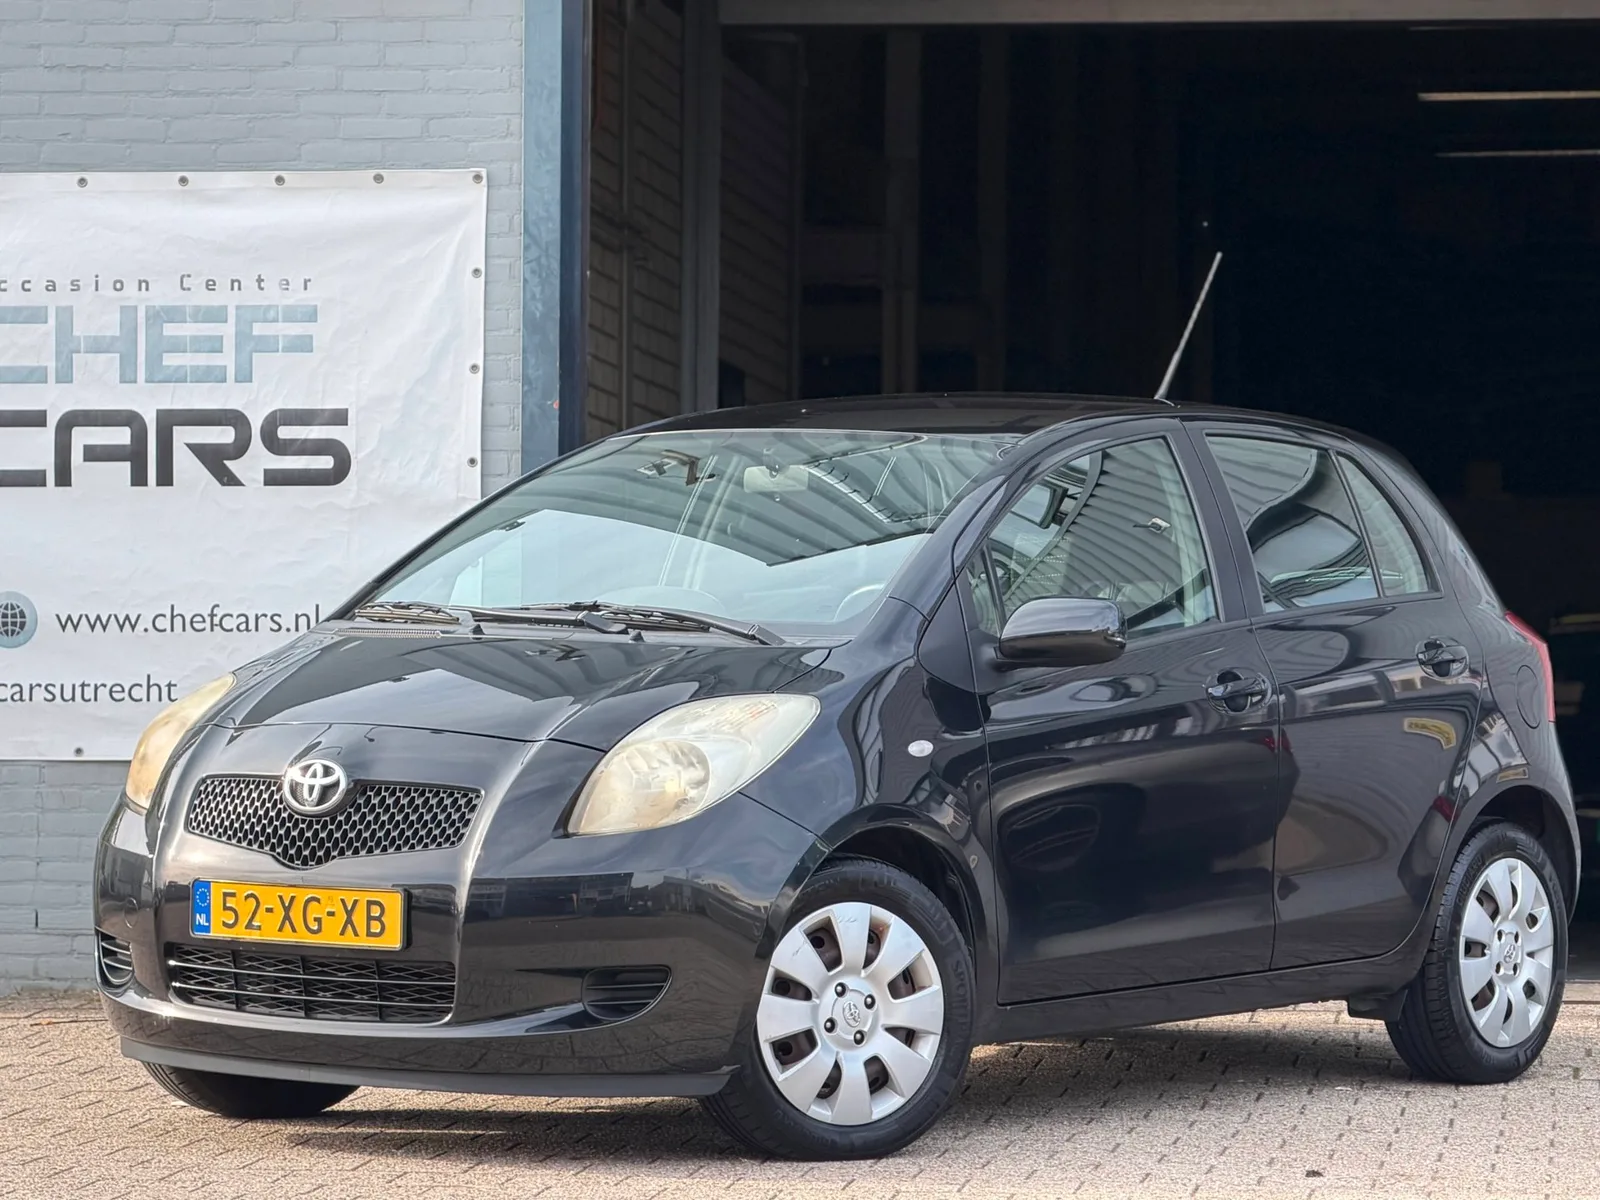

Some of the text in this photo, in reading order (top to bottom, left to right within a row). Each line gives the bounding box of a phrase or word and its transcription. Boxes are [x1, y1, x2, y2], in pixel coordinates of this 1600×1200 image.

[180, 274, 312, 292] Center
[56, 603, 320, 633] www.chefcars.nl
[196, 912, 210, 926] NL
[220, 889, 386, 938] 52-XG-XB
